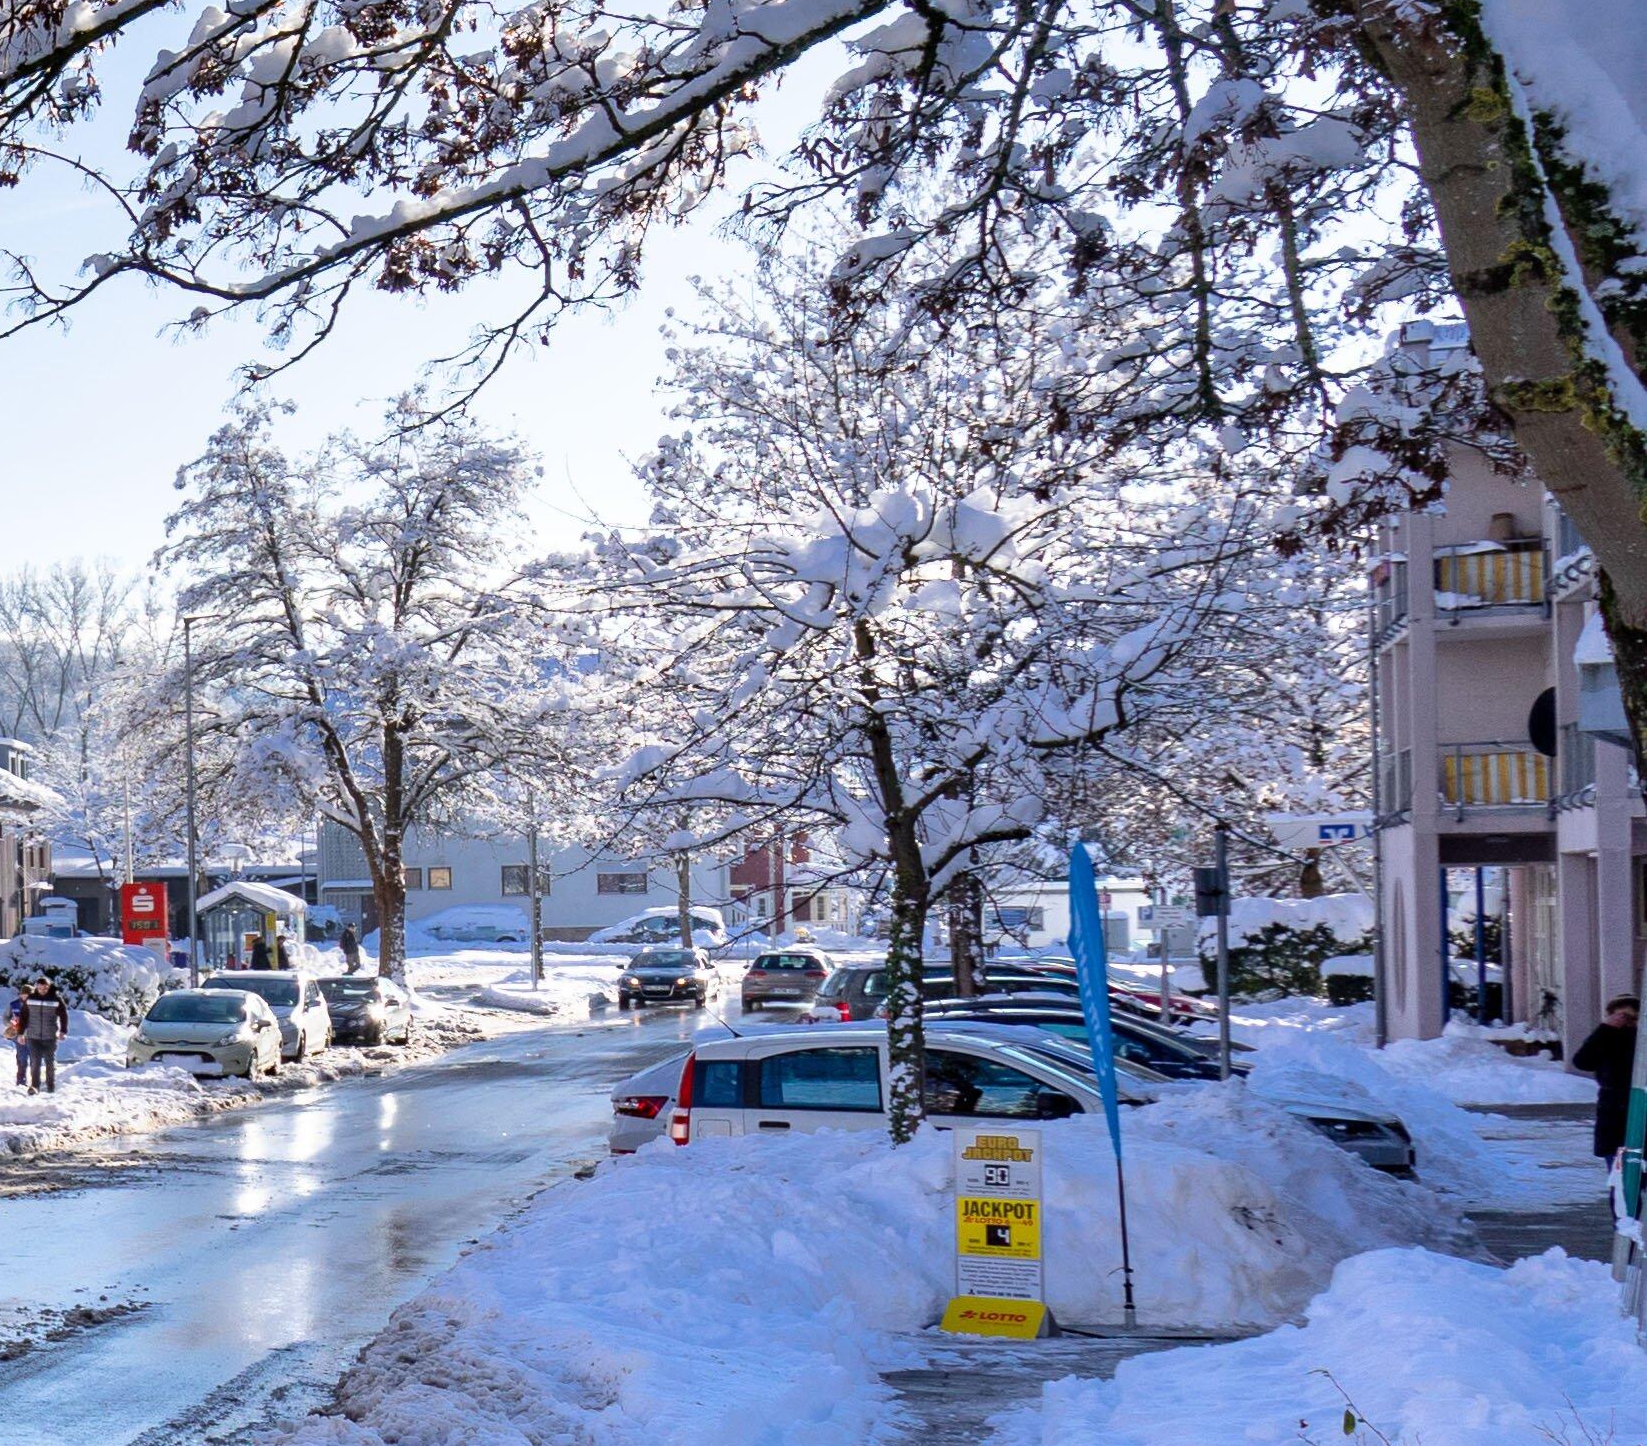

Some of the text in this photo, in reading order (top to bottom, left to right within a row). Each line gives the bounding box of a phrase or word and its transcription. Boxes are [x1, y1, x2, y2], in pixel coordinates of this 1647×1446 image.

[976, 1135, 1020, 1149] EURO
[961, 1147, 1034, 1163] JACKPOT
[985, 1166, 1010, 1184] 90
[962, 1200, 1035, 1220] JACKPOT
[997, 1228, 1011, 1244] 4
[978, 1311, 1027, 1323] LOTTO
